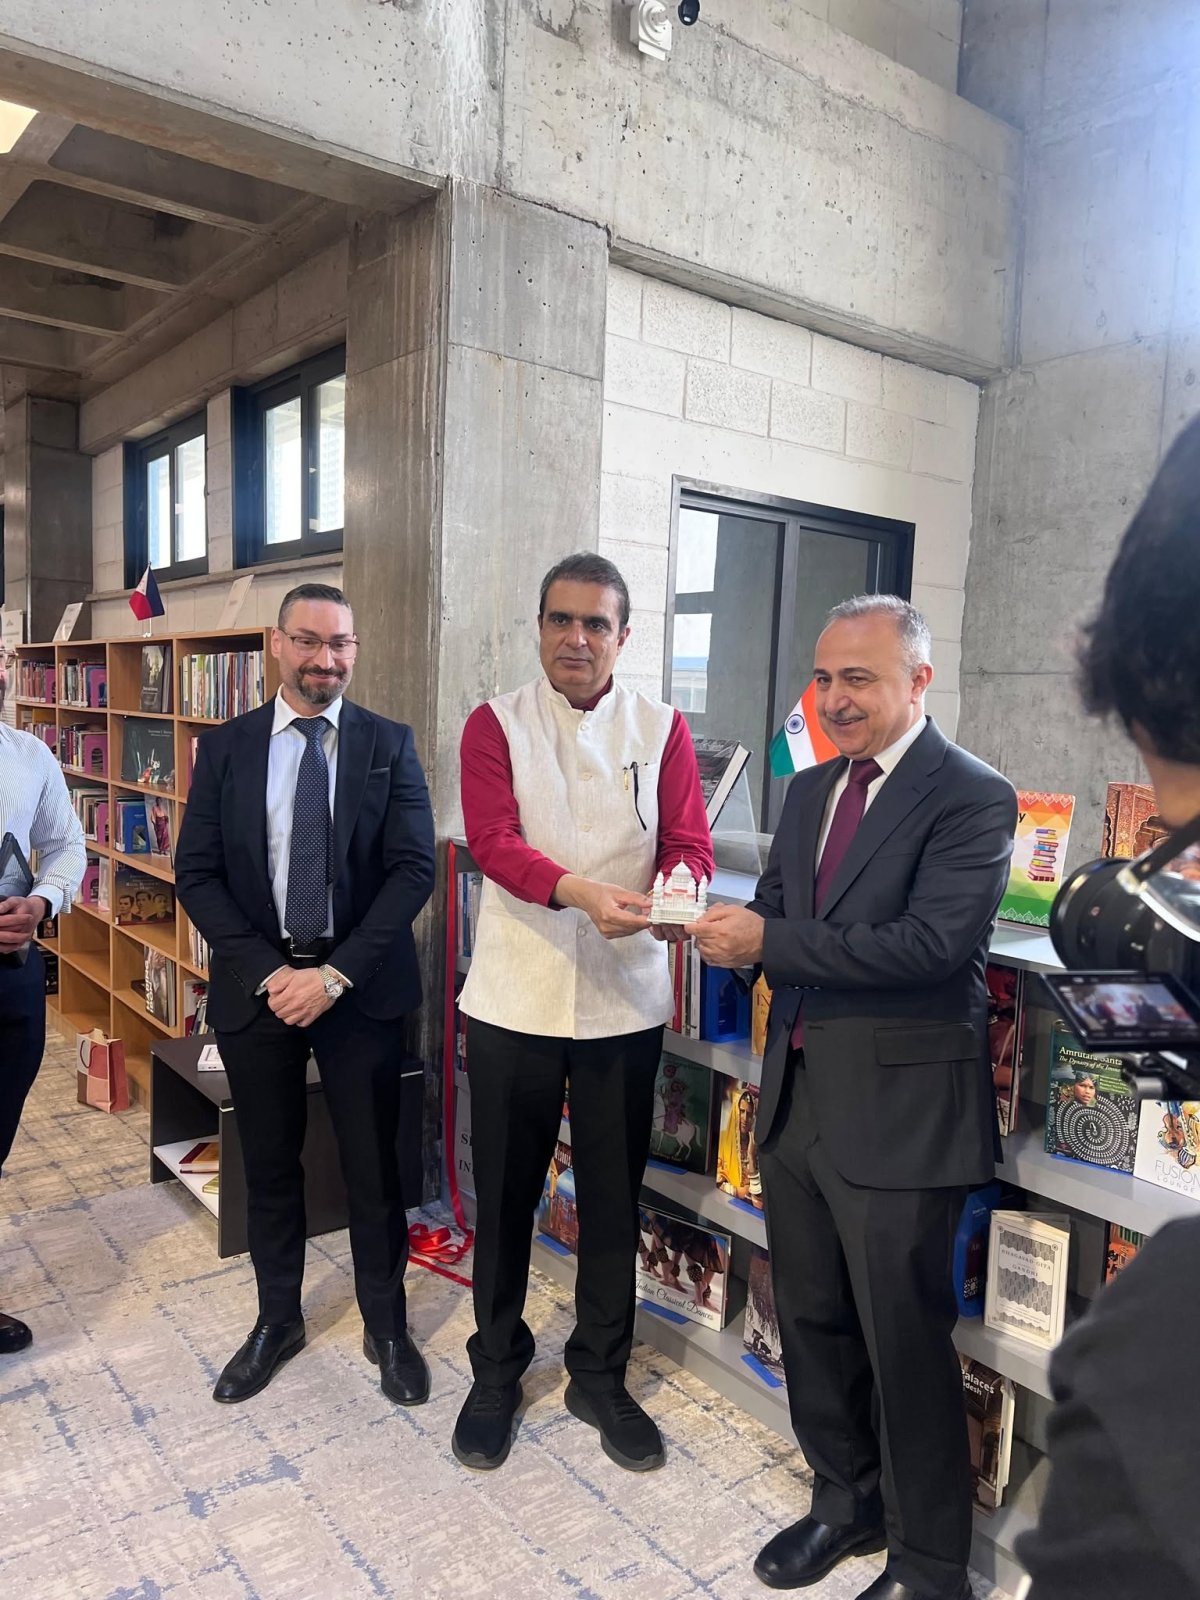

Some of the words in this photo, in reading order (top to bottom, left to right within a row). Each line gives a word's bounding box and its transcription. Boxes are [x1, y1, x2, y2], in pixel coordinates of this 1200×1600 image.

[1155, 1159, 1200, 1188] FUSION
[1157, 1174, 1196, 1193] LOUNGE
[656, 1288, 687, 1308] Classical
[686, 1300, 714, 1321] Dances
[963, 1382, 982, 1395] desh
